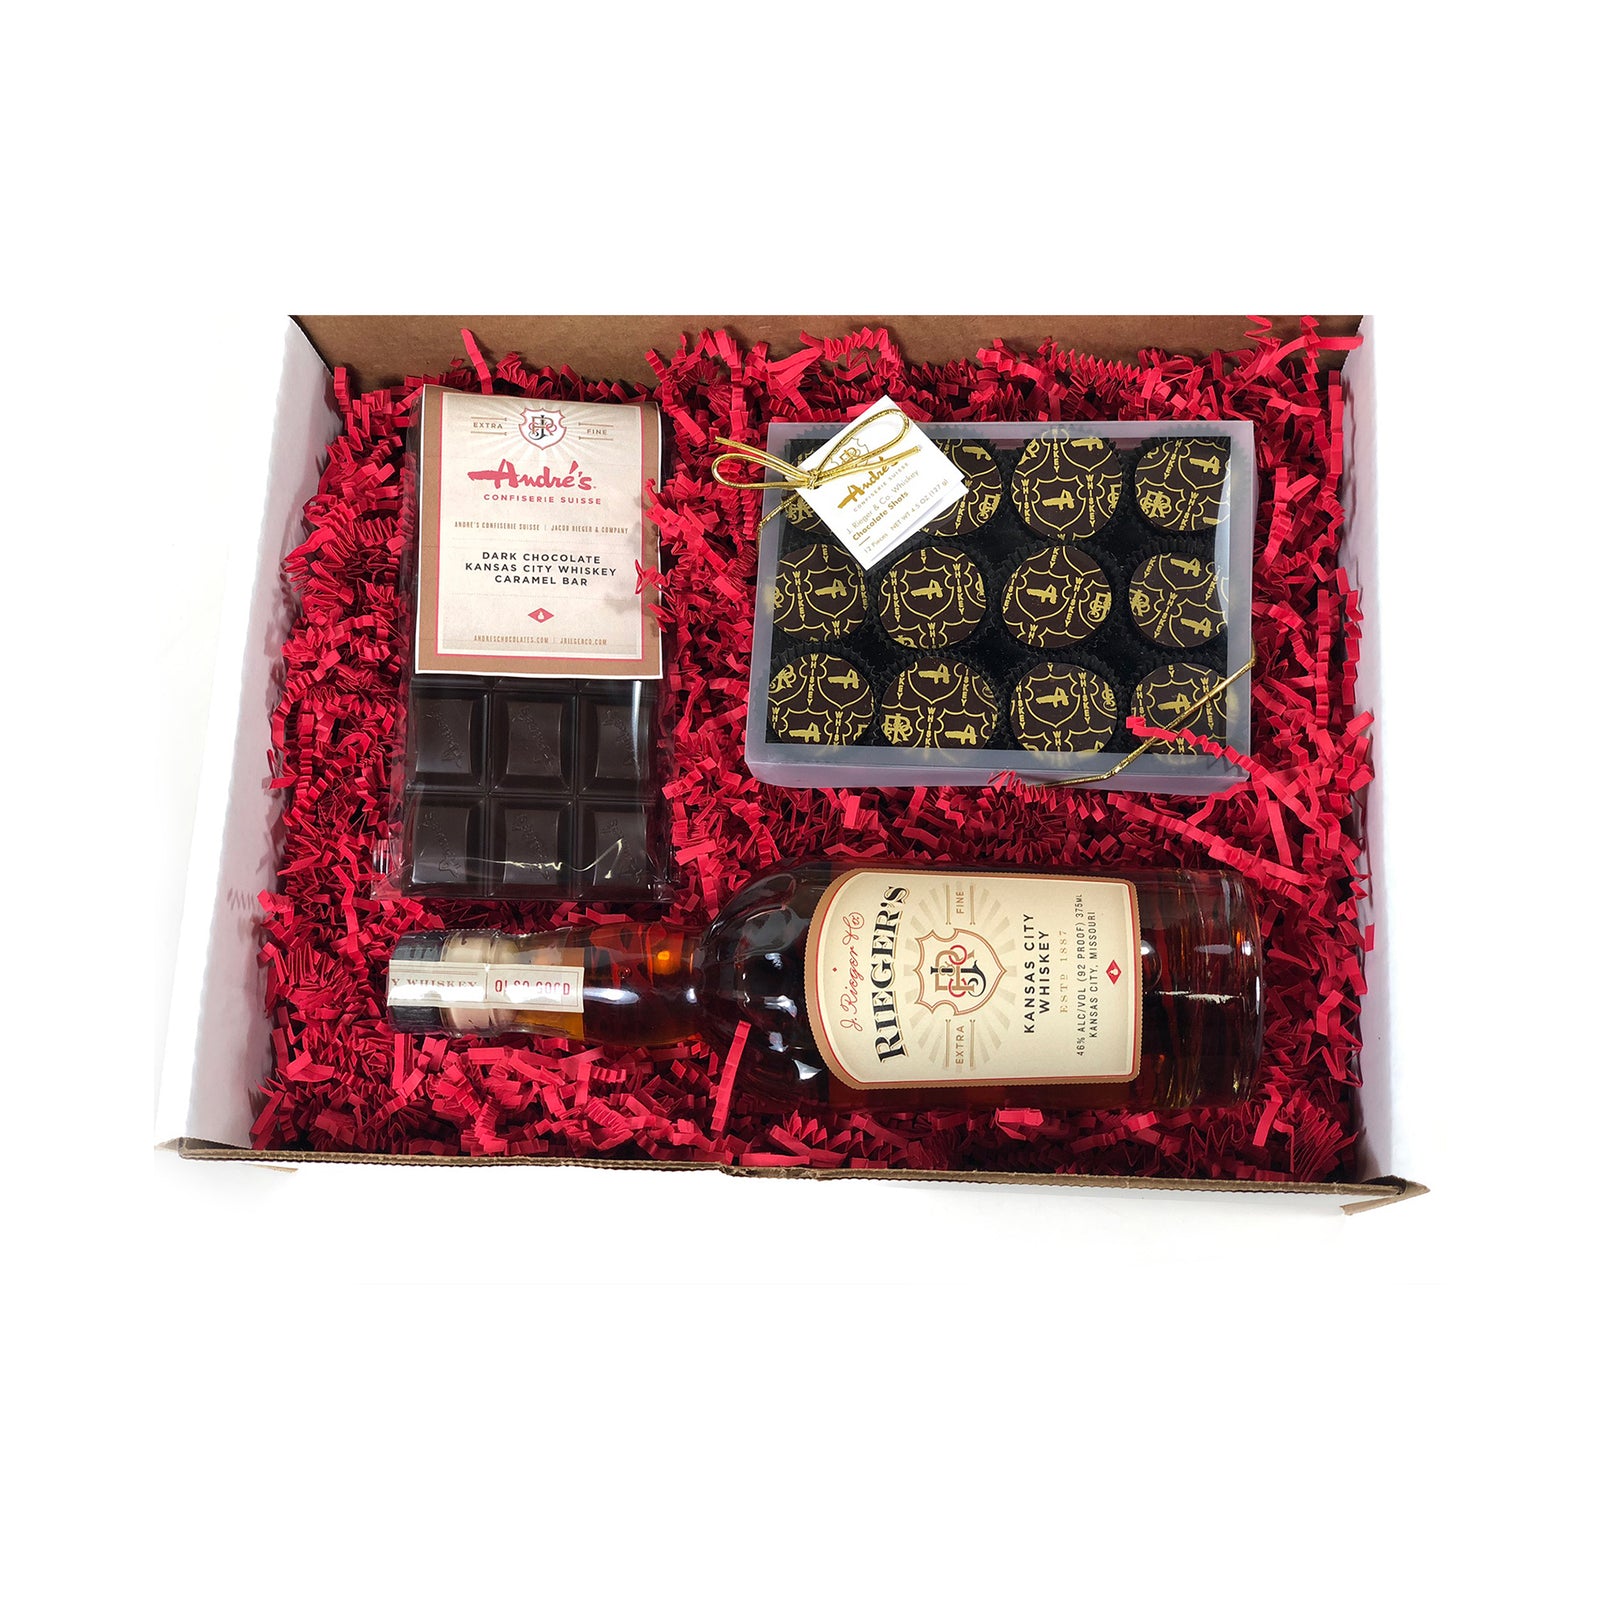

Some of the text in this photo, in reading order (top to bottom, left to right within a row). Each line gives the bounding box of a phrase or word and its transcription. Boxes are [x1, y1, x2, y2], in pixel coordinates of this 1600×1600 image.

[473, 422, 504, 430] EXTRA
[586, 428, 608, 436] FINE
[1052, 428, 1060, 474] HISKEY
[1163, 438, 1183, 480] HISKEY
[483, 493, 602, 505] CONFISERIE SUISSE
[852, 511, 873, 529] Rieger
[891, 470, 920, 494] Whiskey
[852, 491, 909, 541] Chocolate Shots
[890, 518, 903, 531] NET
[901, 511, 912, 522] WT
[1020, 478, 1032, 525] WHISKE
[1086, 474, 1096, 528] WHISKEY
[519, 523, 540, 531] SUISSE
[601, 526, 628, 535] COMPANY
[465, 563, 616, 576] KANSAS CITY WHISKEY
[482, 552, 601, 564] DARK CHOCOLATE
[495, 575, 588, 586] CARAMEL BAR
[792, 570, 806, 622] WHISKEY
[889, 570, 901, 622] WHISKEY
[952, 563, 965, 616] WHISKEY
[1002, 566, 1021, 614] HISKEY
[1065, 577, 1084, 628] WHISKEY
[1154, 592, 1178, 638] WHISKEY
[807, 654, 819, 707] WHISKEY
[1078, 672, 1091, 724] WHISKEY
[1200, 677, 1214, 730] WHSKEY
[1015, 682, 1026, 730] HISKEY
[956, 890, 965, 914] FINE
[1058, 930, 1068, 962] 1887
[1075, 922, 1086, 960] PROOF)
[1088, 911, 1098, 960] MISSOURI
[840, 946, 864, 1015] Rieger
[870, 885, 910, 1063] RIEGER'S
[1023, 914, 1036, 1034] KANSAS CITY
[1038, 930, 1050, 1014] WHISKEY
[1077, 964, 1088, 982] (92
[1077, 988, 1087, 1032] ALC/VOL
[1088, 998, 1099, 1038] KANSAS
[956, 1025, 965, 1065] EXTRA
[1076, 1036, 1086, 1057] 46%
